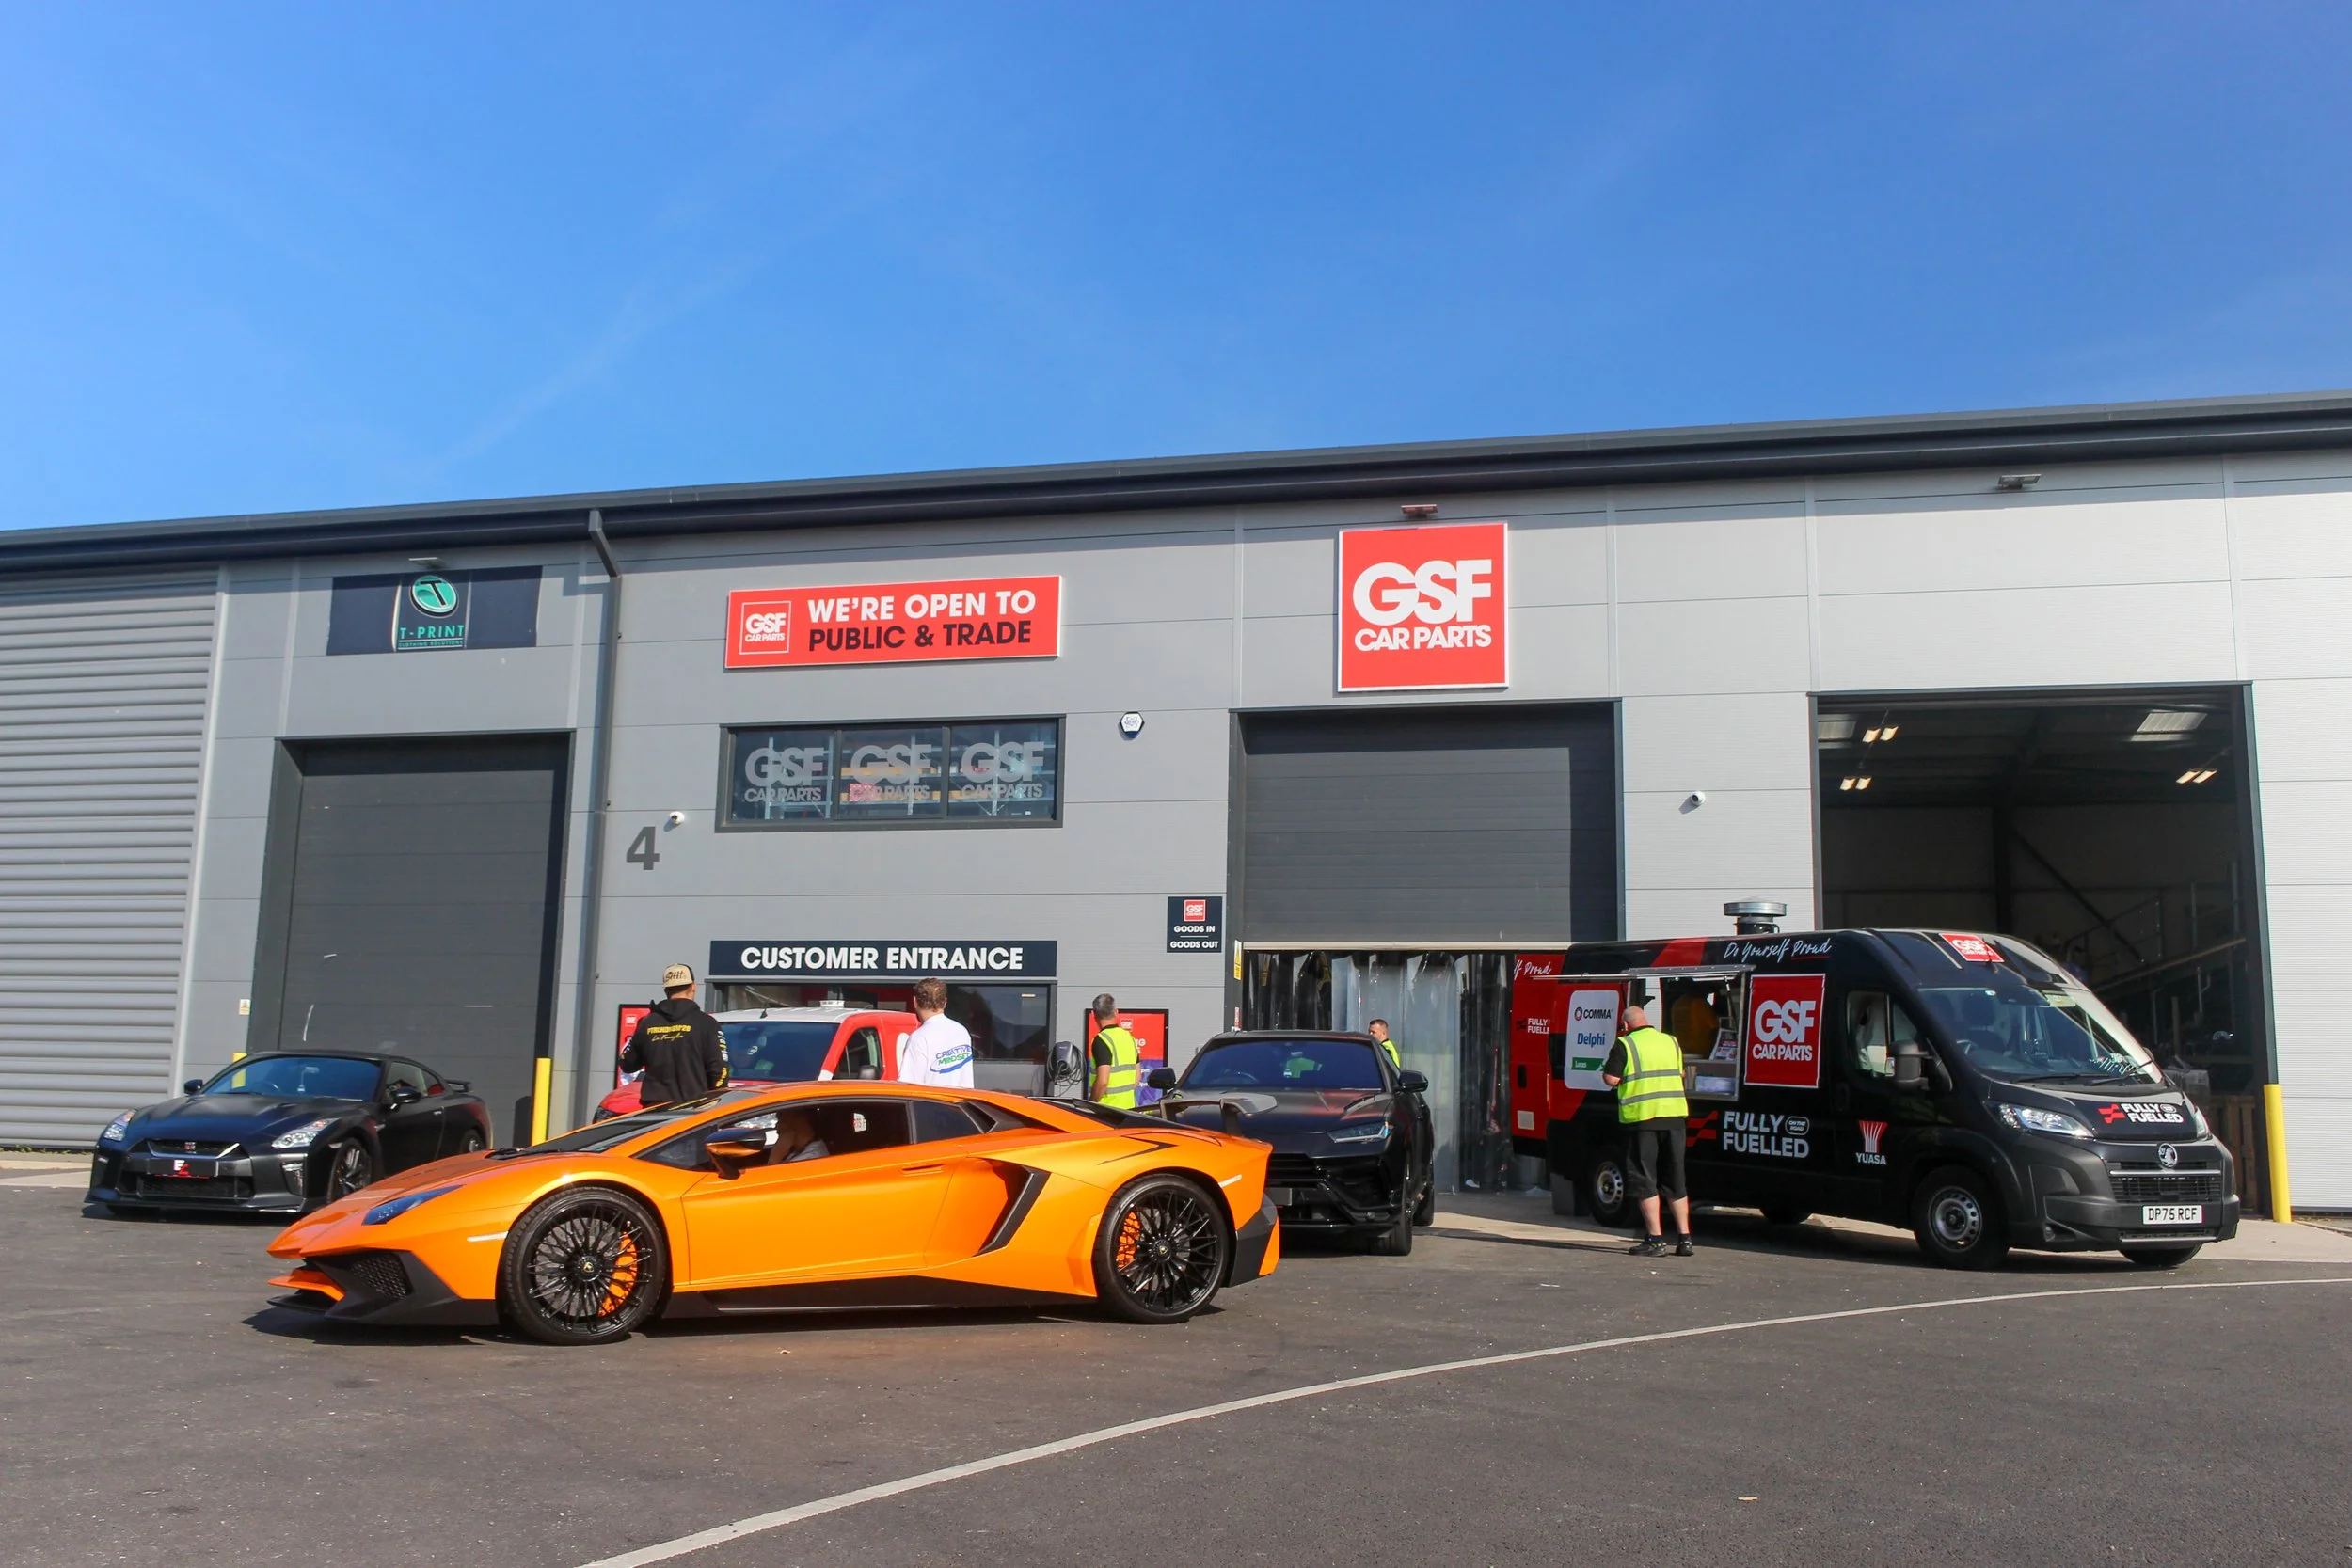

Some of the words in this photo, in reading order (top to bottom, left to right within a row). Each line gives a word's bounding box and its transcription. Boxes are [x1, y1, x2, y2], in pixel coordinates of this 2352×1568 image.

[1353, 559, 1493, 626] GSF
[807, 595, 894, 624] WE'RE
[904, 592, 986, 619] OPEN
[995, 589, 1036, 614] TO
[746, 612, 787, 634] GSF
[400, 625, 465, 640] T-PRINT
[745, 633, 761, 642] CAR
[762, 632, 786, 641] PARTS
[809, 624, 905, 651] PUBLIC
[914, 625, 935, 647] &
[943, 620, 1032, 646] TRADE
[1354, 627, 1410, 652] CAR
[1413, 624, 1492, 649] PARTS
[745, 747, 825, 786] GSF
[850, 744, 932, 784] GSF
[961, 741, 1045, 783] GSF
[744, 786, 777, 803] CAR
[778, 786, 821, 802] PARTS
[850, 785, 884, 802] CAR
[885, 784, 930, 801] PARTS
[961, 784, 997, 800] CAR
[999, 782, 1043, 800] PARTS
[626, 826, 660, 871] 4
[1186, 905, 1203, 913] GSF
[1173, 925, 1205, 933] GOODS
[1206, 925, 1216, 933] IN
[1169, 941, 1201, 949] GOODS
[1201, 941, 1219, 949] OUT
[1723, 942, 1740, 958] Do
[1741, 939, 1790, 963] Yourself
[1791, 938, 1832, 957] Proud
[740, 946, 879, 970] CUSTOMER
[886, 946, 1024, 971] ENTRANCE
[1523, 961, 1552, 976] Proud
[1527, 1018, 1549, 1026] FULLY
[1583, 1008, 1612, 1020] COMMA
[1755, 1000, 1816, 1043] GSF
[1577, 1033, 1606, 1048] Delphi
[935, 1045, 972, 1060] CREATIVE
[938, 1052, 971, 1066] MINDSET
[1752, 1044, 1776, 1060] CAR
[1777, 1044, 1813, 1061] PARTS
[2121, 1103, 2161, 1113] FULLY
[1724, 1111, 1784, 1133] FULLY
[2127, 1113, 2184, 1123] FUELLED
[1723, 1132, 1810, 1158] FUELLED
[1855, 1152, 1887, 1166] YUASA
[2148, 1208, 2175, 1221] DP75
[2178, 1207, 2197, 1220] RCF
